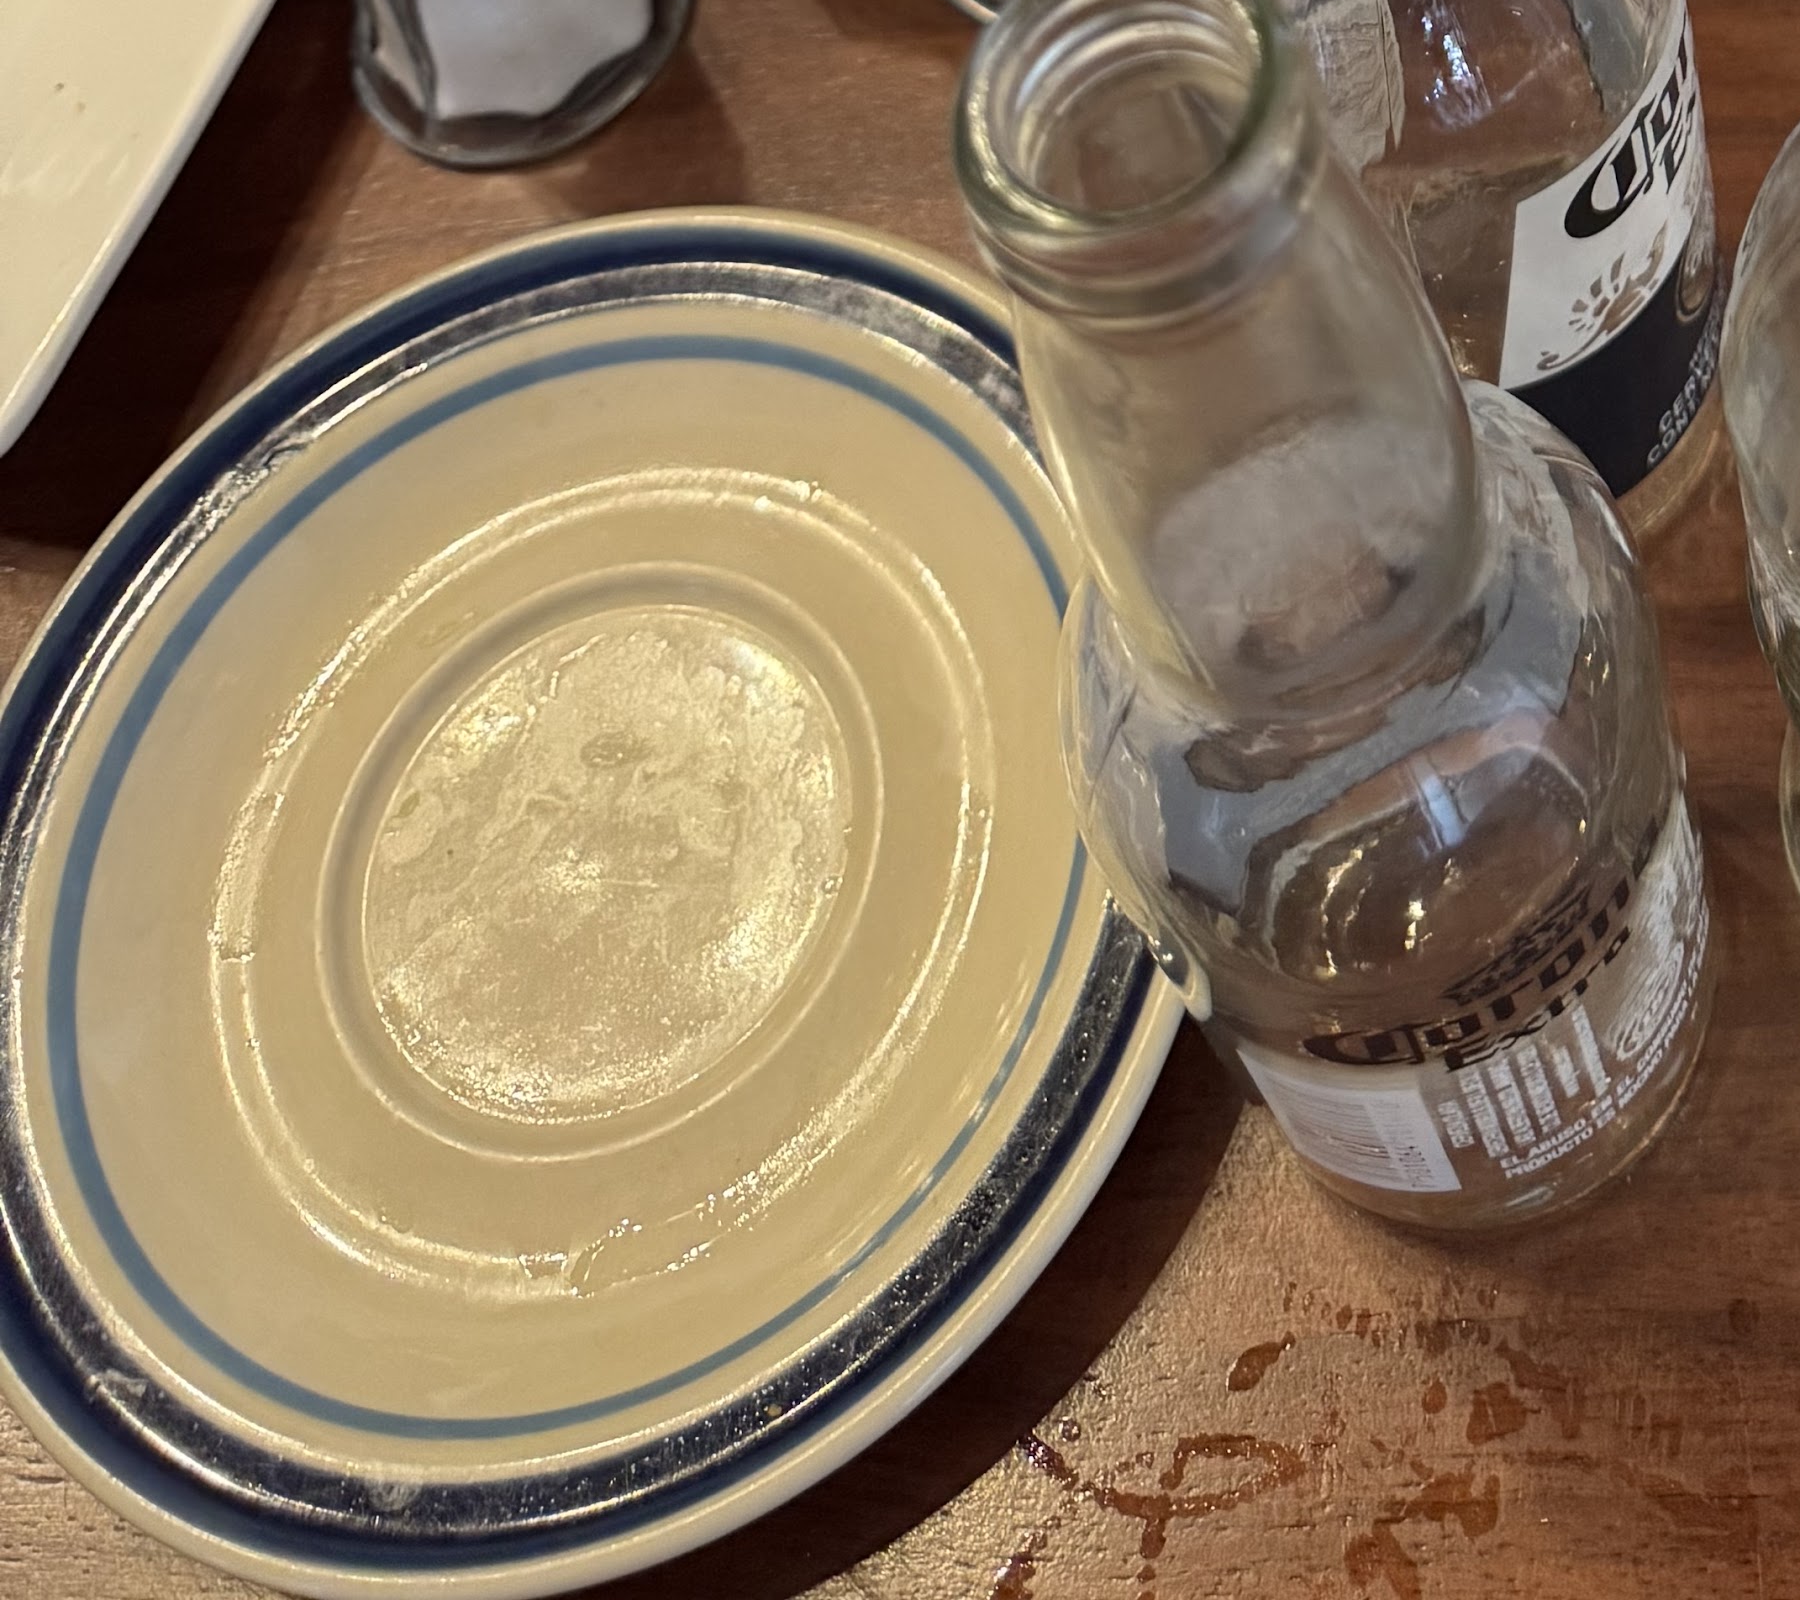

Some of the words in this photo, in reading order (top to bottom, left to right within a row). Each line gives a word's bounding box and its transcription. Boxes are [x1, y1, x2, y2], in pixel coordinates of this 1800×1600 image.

[1302, 817, 1661, 1065] Corona
[1444, 925, 1631, 1073] Extra
[1500, 1155, 1520, 1169] EL
[1527, 1119, 1587, 1161] ABUSO
[1590, 1094, 1613, 1119] EN
[1616, 1074, 1637, 1097] EL
[1504, 1126, 1593, 1179] PRODUCTO
[1597, 1106, 1616, 1129] ES
[1618, 1048, 1663, 1109] NOCIVO
